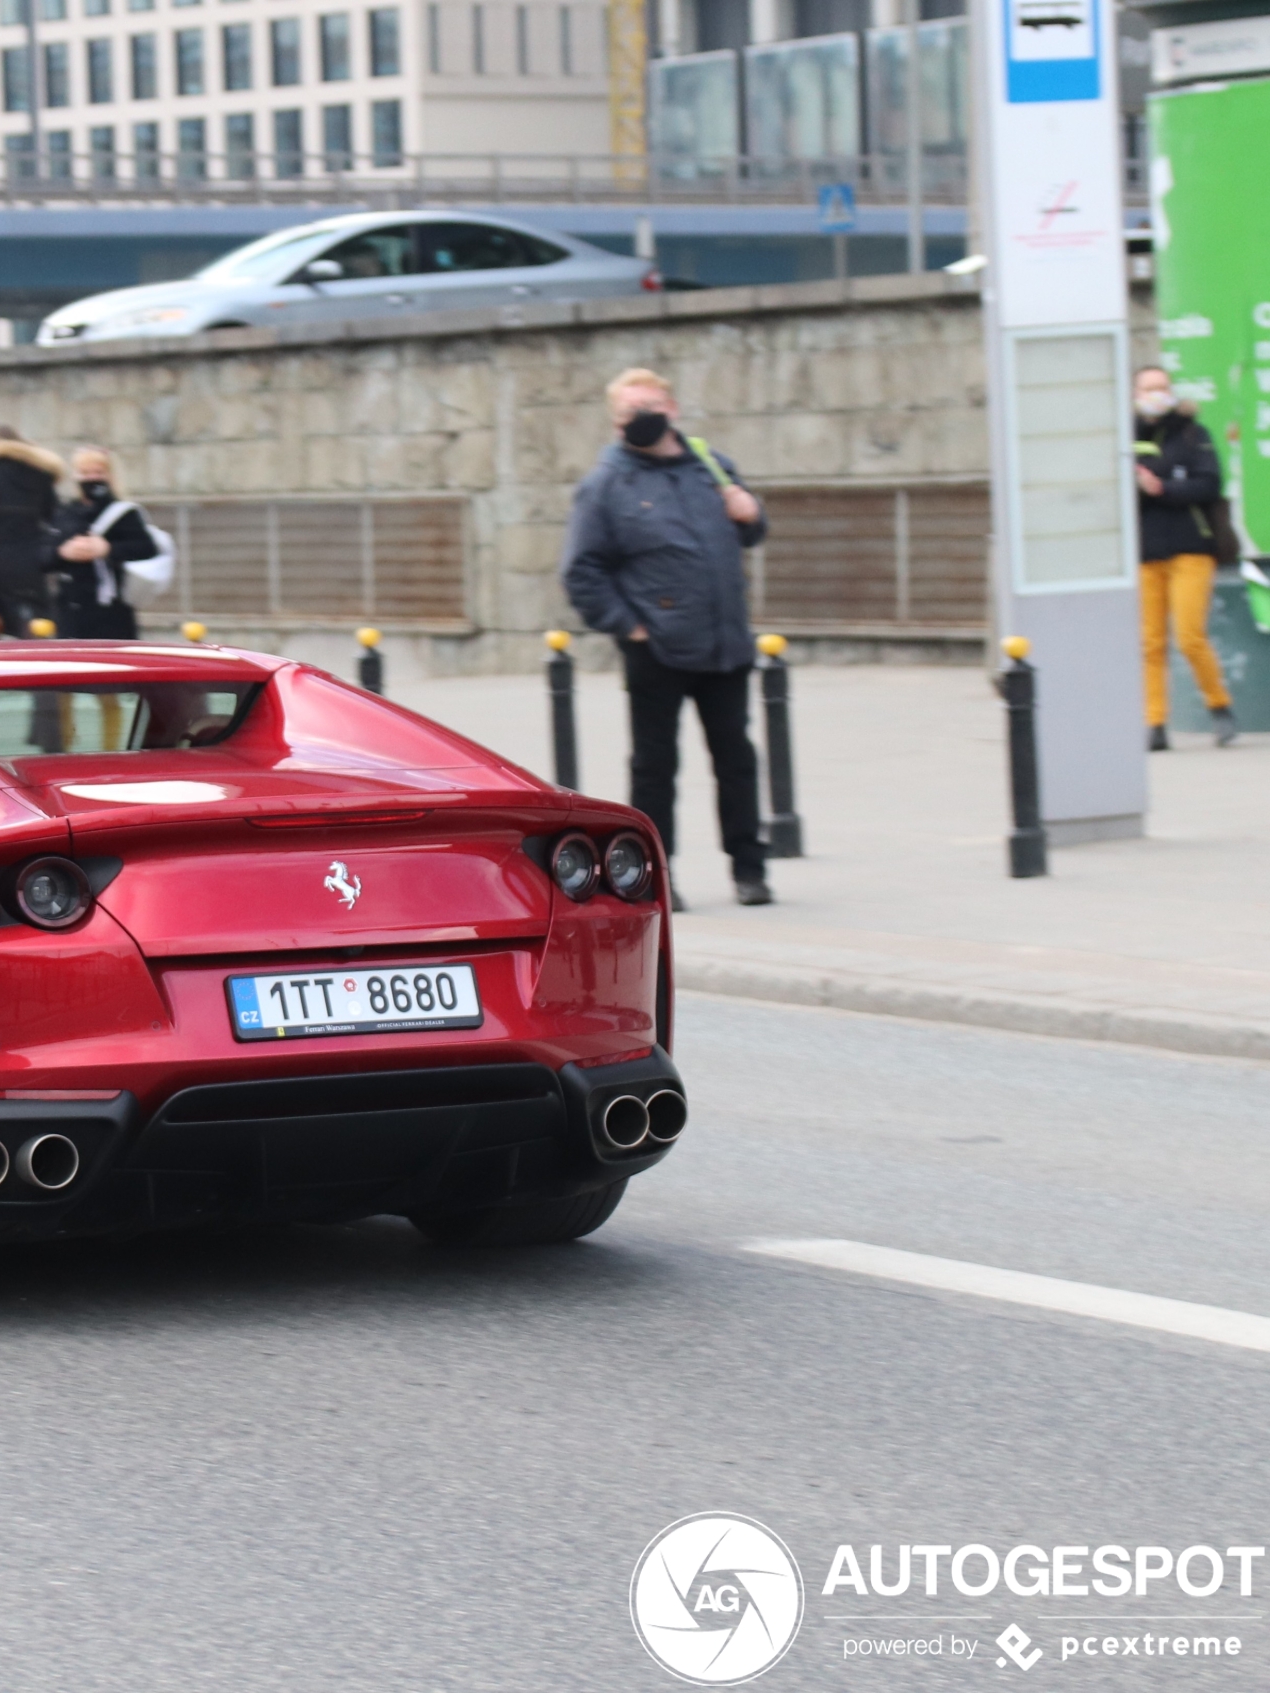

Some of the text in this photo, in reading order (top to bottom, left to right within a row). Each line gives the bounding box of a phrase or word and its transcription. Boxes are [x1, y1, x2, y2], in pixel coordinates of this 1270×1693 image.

[270, 972, 458, 1020] 1TT 8680
[241, 1010, 260, 1024] CZ
[304, 1024, 356, 1033] Ferrari Warszawa
[376, 1021, 401, 1029] OFFICIAL
